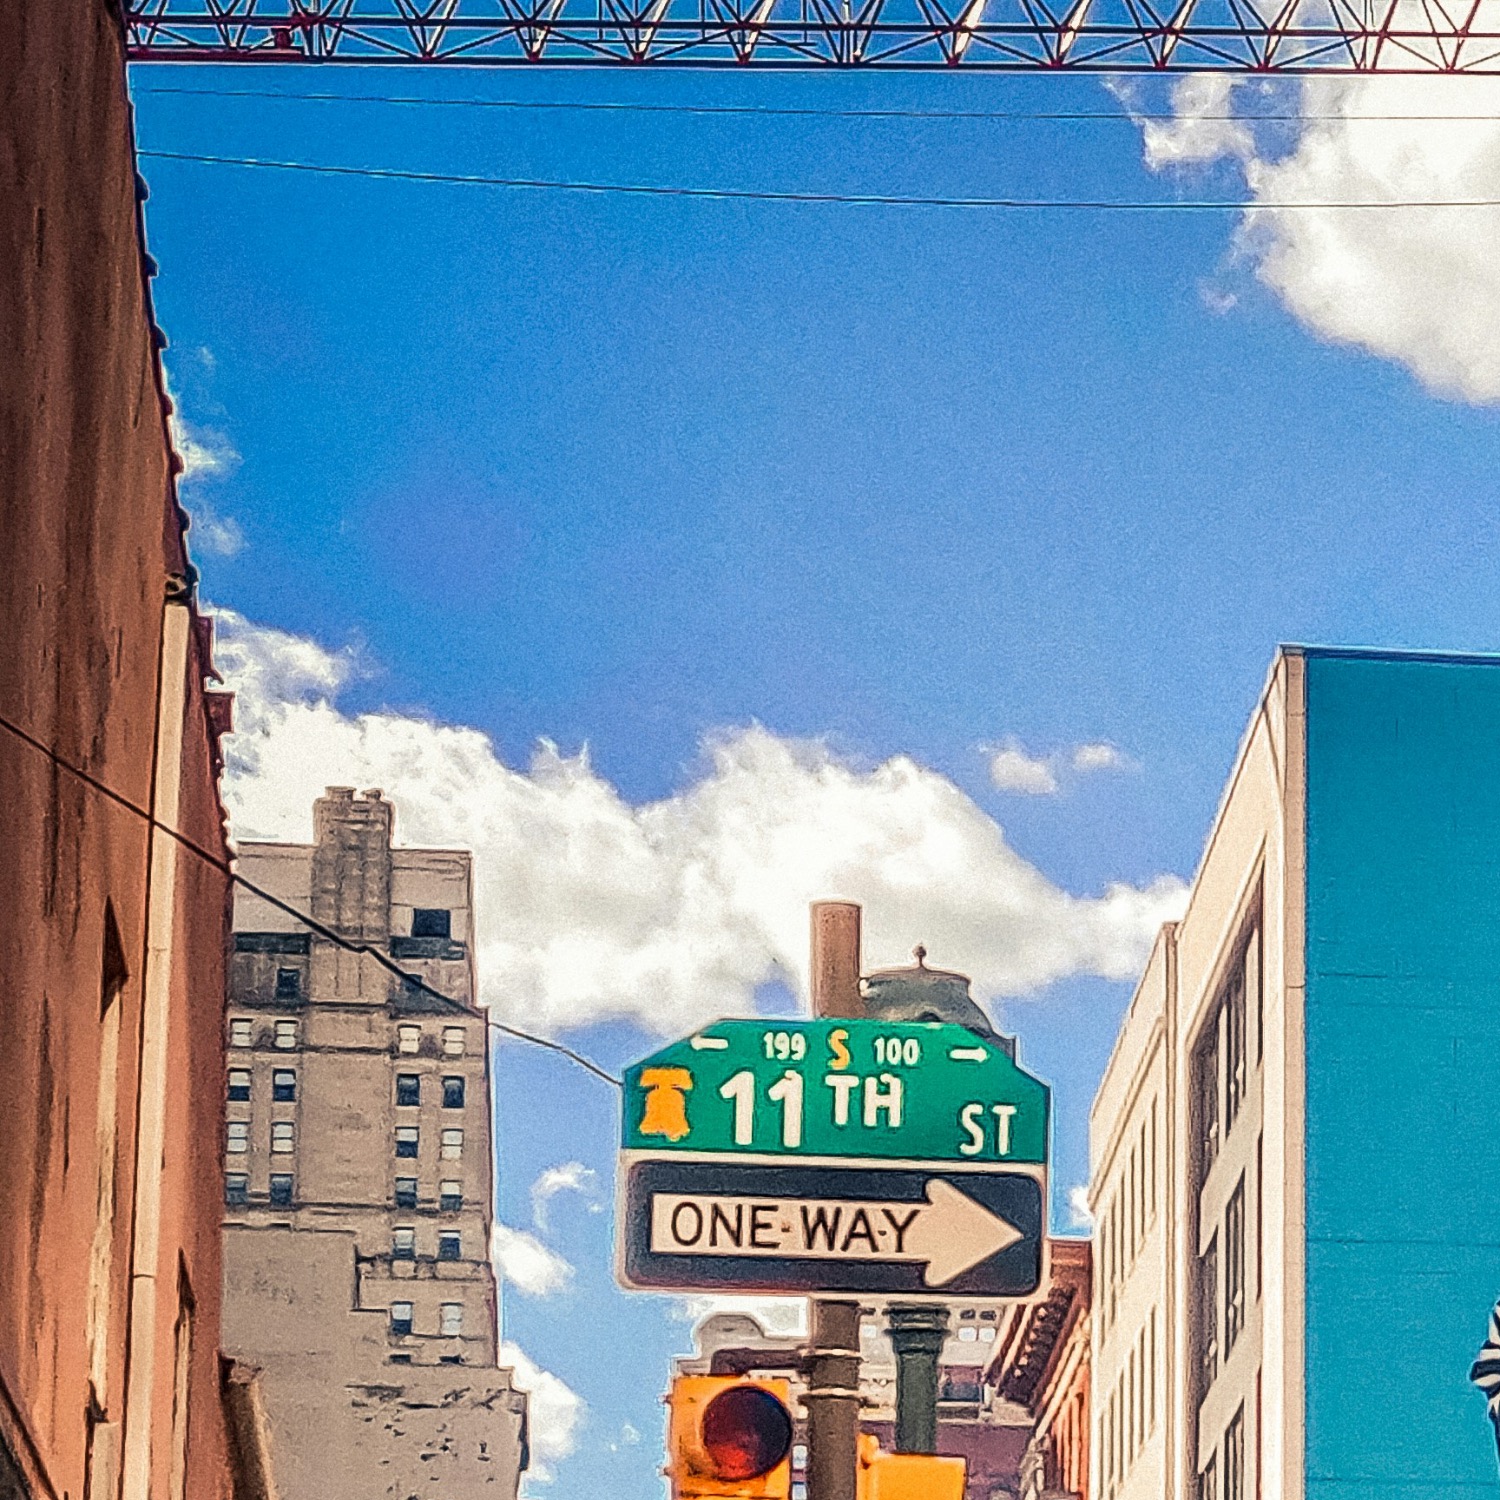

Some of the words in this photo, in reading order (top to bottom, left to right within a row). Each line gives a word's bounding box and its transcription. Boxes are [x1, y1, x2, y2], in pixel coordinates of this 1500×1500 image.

[764, 1032, 806, 1061] 199
[828, 1029, 850, 1070] S
[874, 1037, 920, 1066] 100
[959, 1103, 1017, 1156] ST
[671, 1201, 781, 1250] ONE
[800, 1204, 920, 1253] WAY
